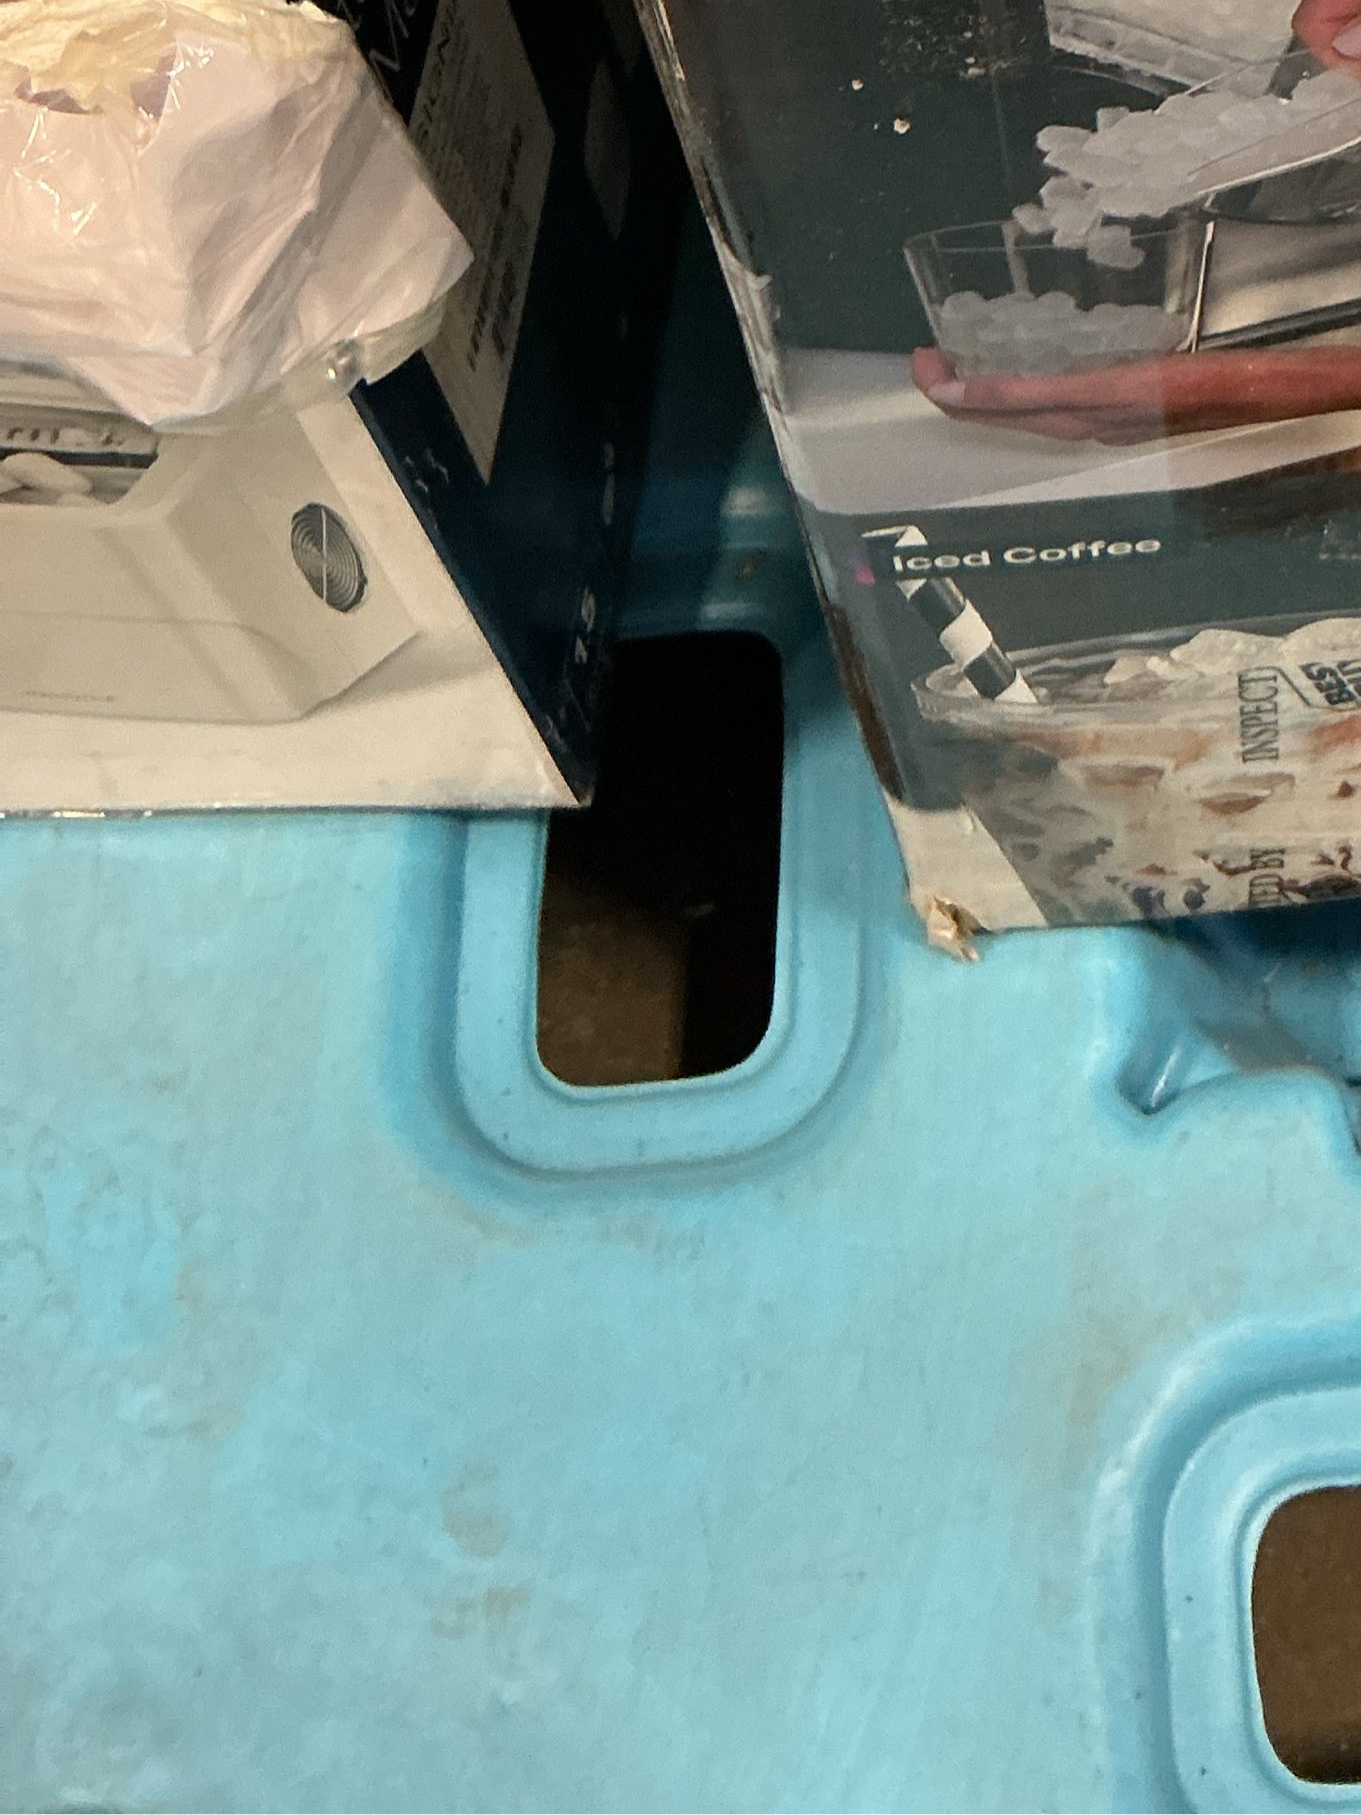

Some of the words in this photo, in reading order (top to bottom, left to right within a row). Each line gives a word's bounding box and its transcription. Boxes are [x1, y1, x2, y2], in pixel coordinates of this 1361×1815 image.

[893, 549, 991, 572] Iced
[1003, 539, 1161, 564] Coffee
[1250, 847, 1286, 870] BY
